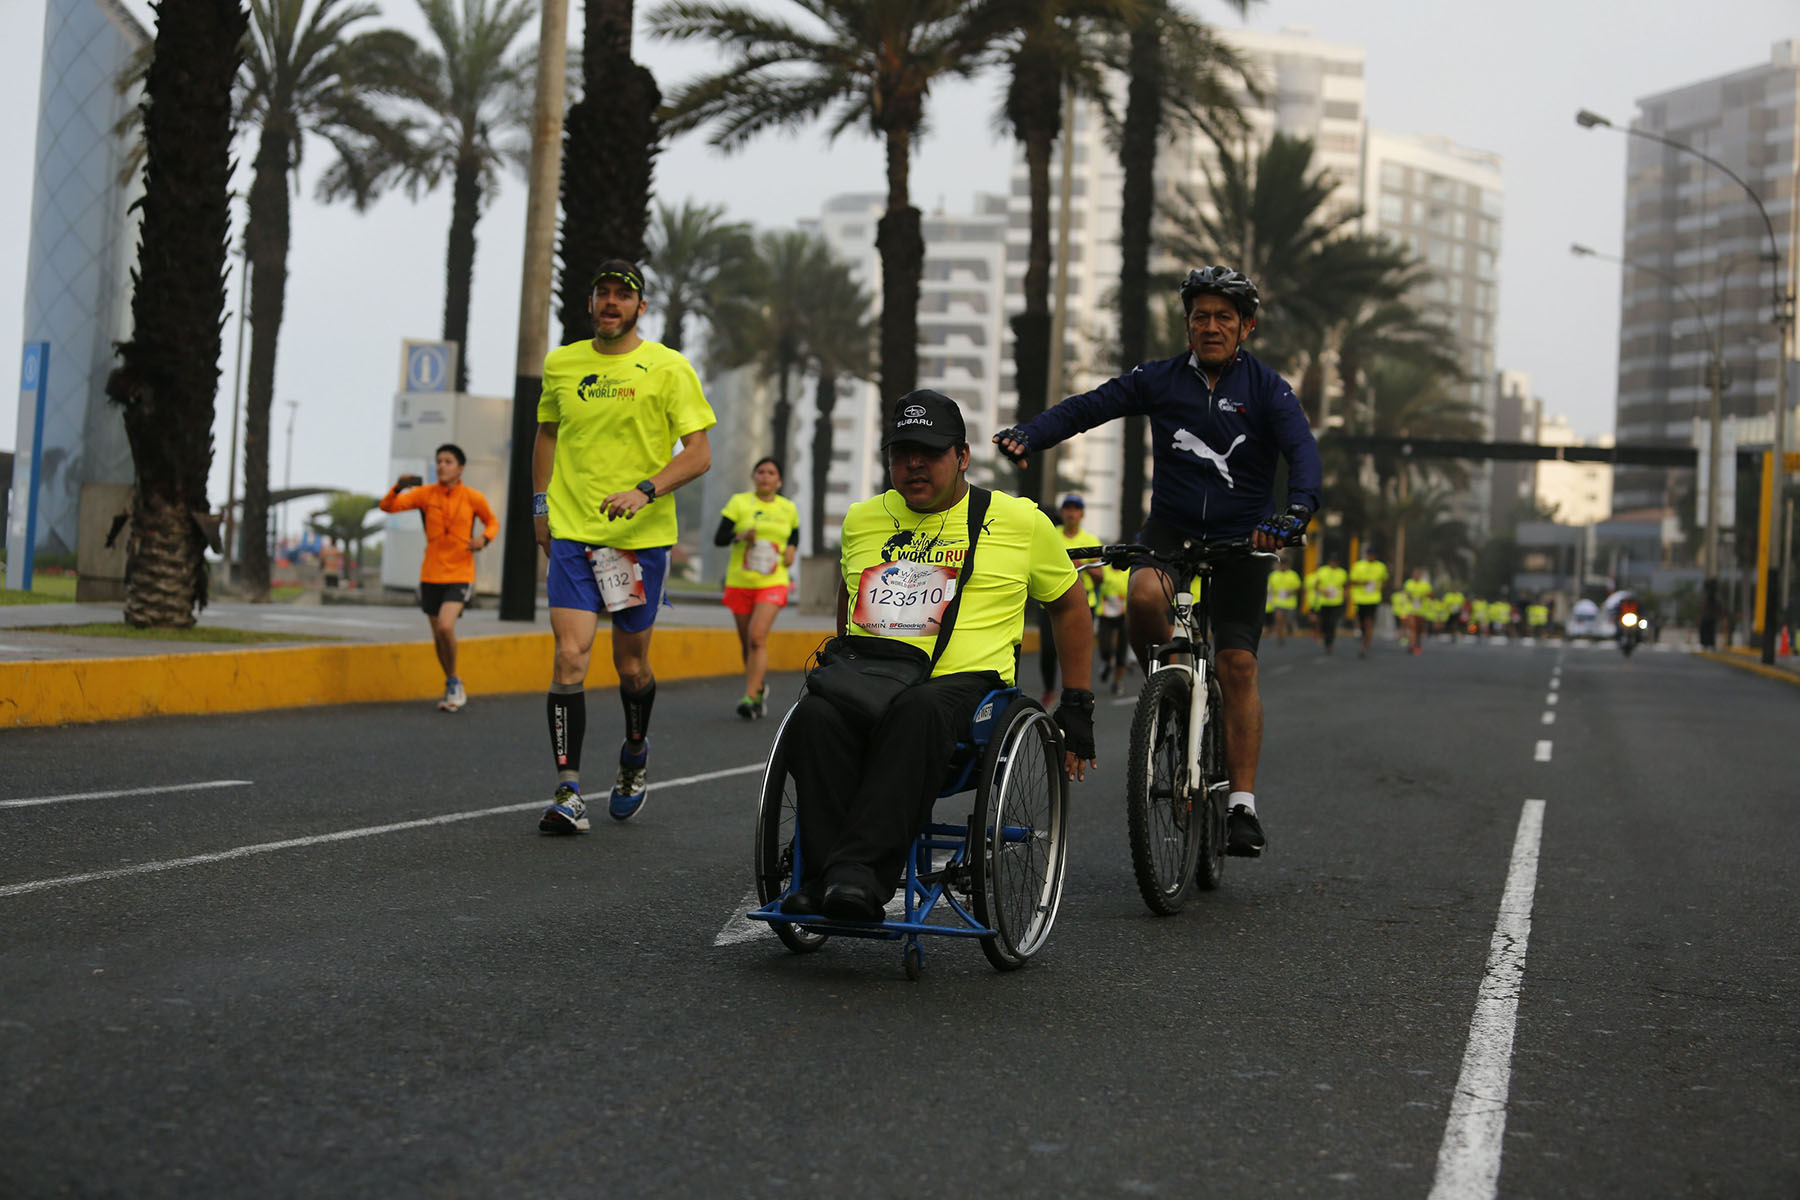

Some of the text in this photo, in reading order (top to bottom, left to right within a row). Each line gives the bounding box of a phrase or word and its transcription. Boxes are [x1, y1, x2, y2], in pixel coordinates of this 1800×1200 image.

[588, 387, 635, 398] WORLD RUN
[897, 418, 933, 428] SUBARU
[897, 550, 944, 563] WORLD
[869, 587, 943, 607] 123510
[889, 622, 927, 630] BFGoodrich
